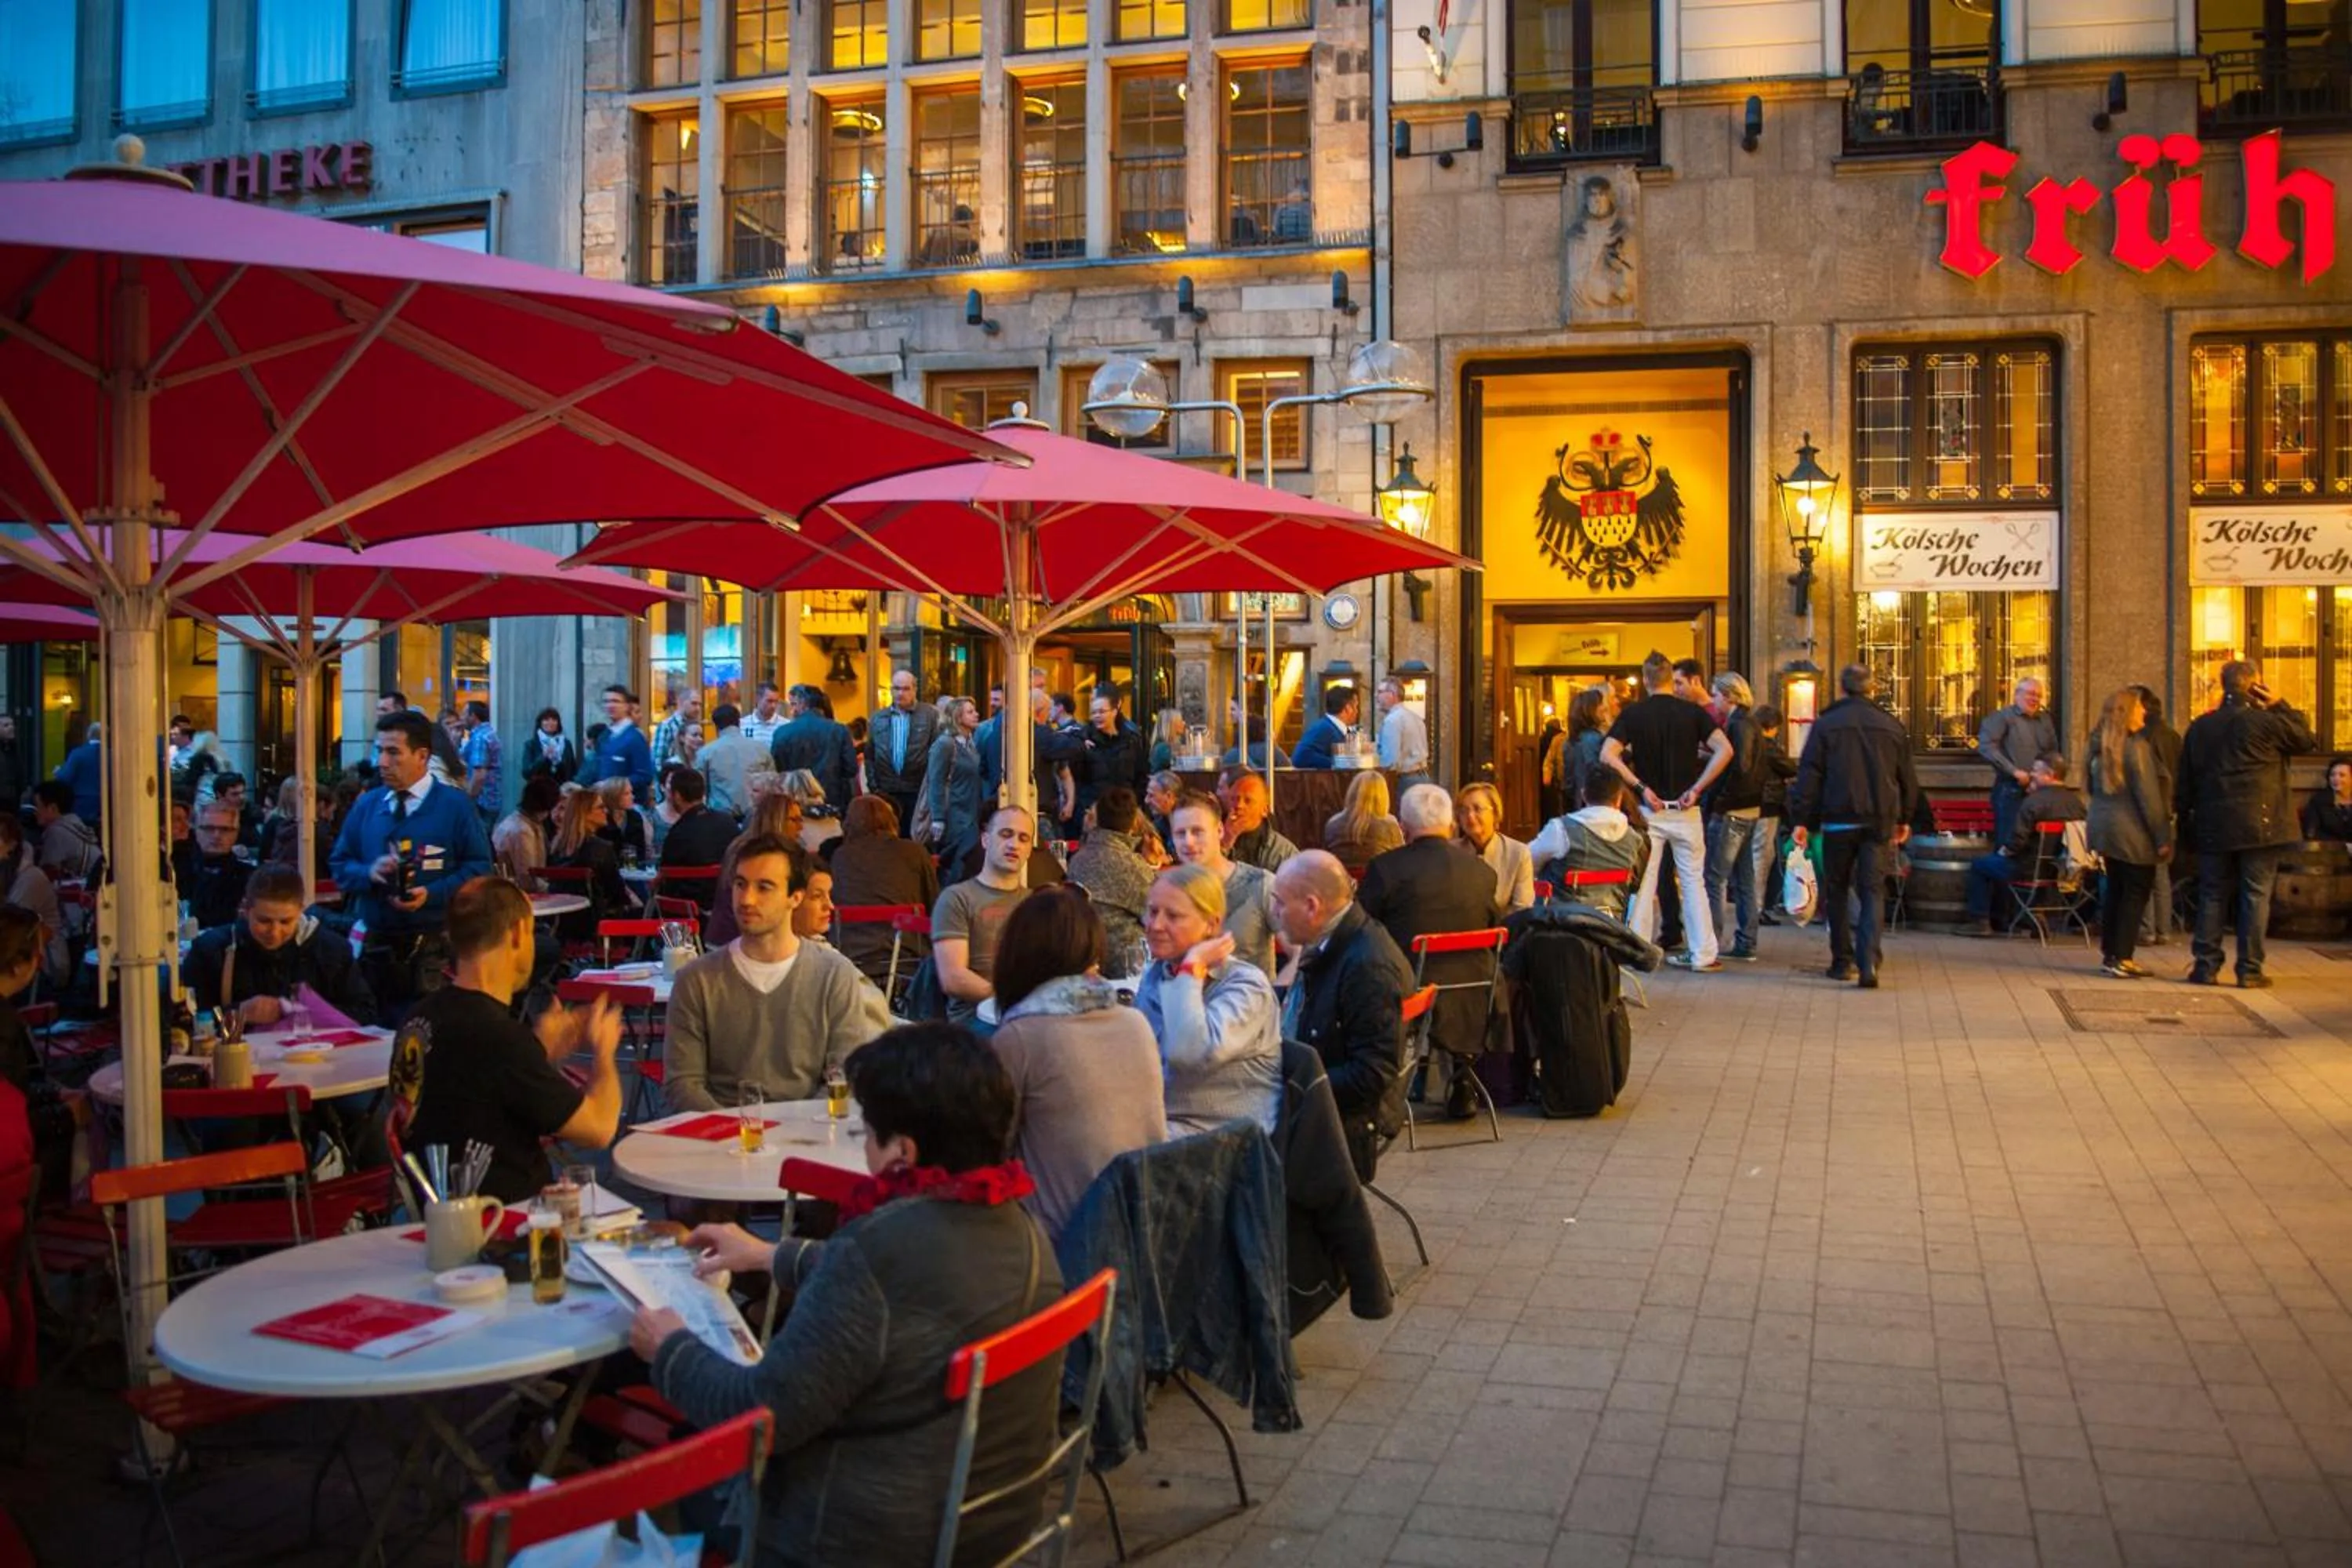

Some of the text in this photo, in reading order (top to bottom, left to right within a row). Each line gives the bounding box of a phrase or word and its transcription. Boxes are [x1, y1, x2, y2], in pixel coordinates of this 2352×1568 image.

[1923, 127, 2336, 287] früh
[1870, 527, 1980, 552] Kölsche
[2201, 519, 2318, 546] Kölsche
[1929, 554, 2043, 581] Wochen
[2261, 546, 2352, 575] Woch
